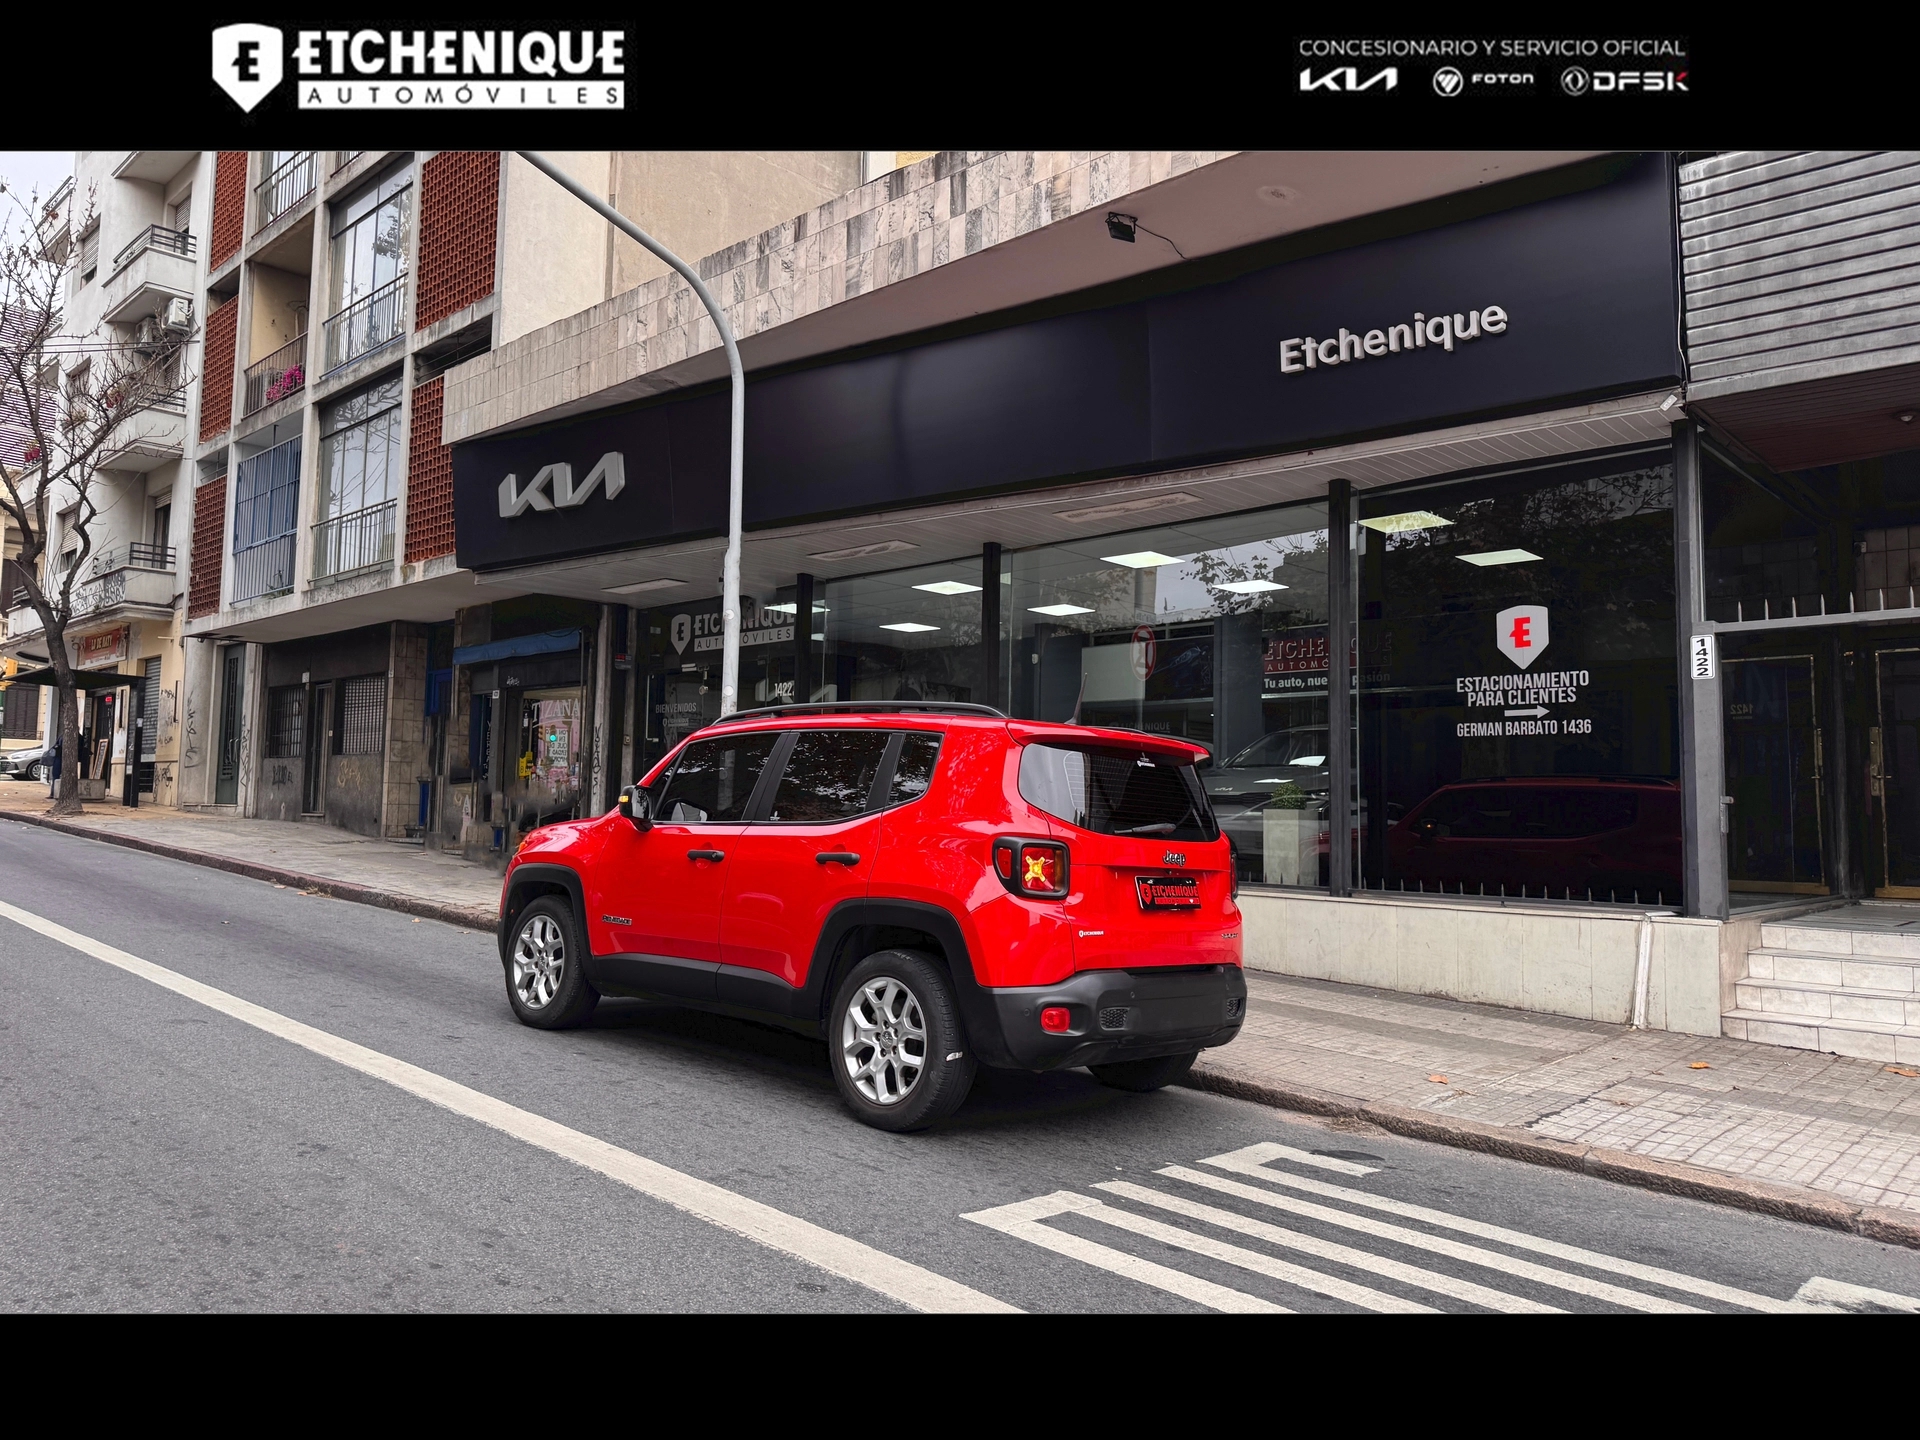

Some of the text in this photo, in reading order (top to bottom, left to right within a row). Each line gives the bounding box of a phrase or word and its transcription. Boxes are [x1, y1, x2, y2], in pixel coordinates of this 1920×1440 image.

[1280, 305, 1508, 373] Etchenique
[498, 451, 625, 518] KIA
[1695, 638, 1709, 676] 1422
[1264, 678, 1276, 689] Tu
[1278, 677, 1305, 688] auto,
[1456, 670, 1589, 692] ESTACIONAMIENTO
[1467, 687, 1577, 707] PARA CLIENTES
[656, 703, 697, 714] BIENVENIDOS
[1457, 719, 1592, 737] GERMAN BARBATO 1436
[1163, 850, 1186, 867] Jeep
[1152, 885, 1198, 897] ETCHENIQUE
